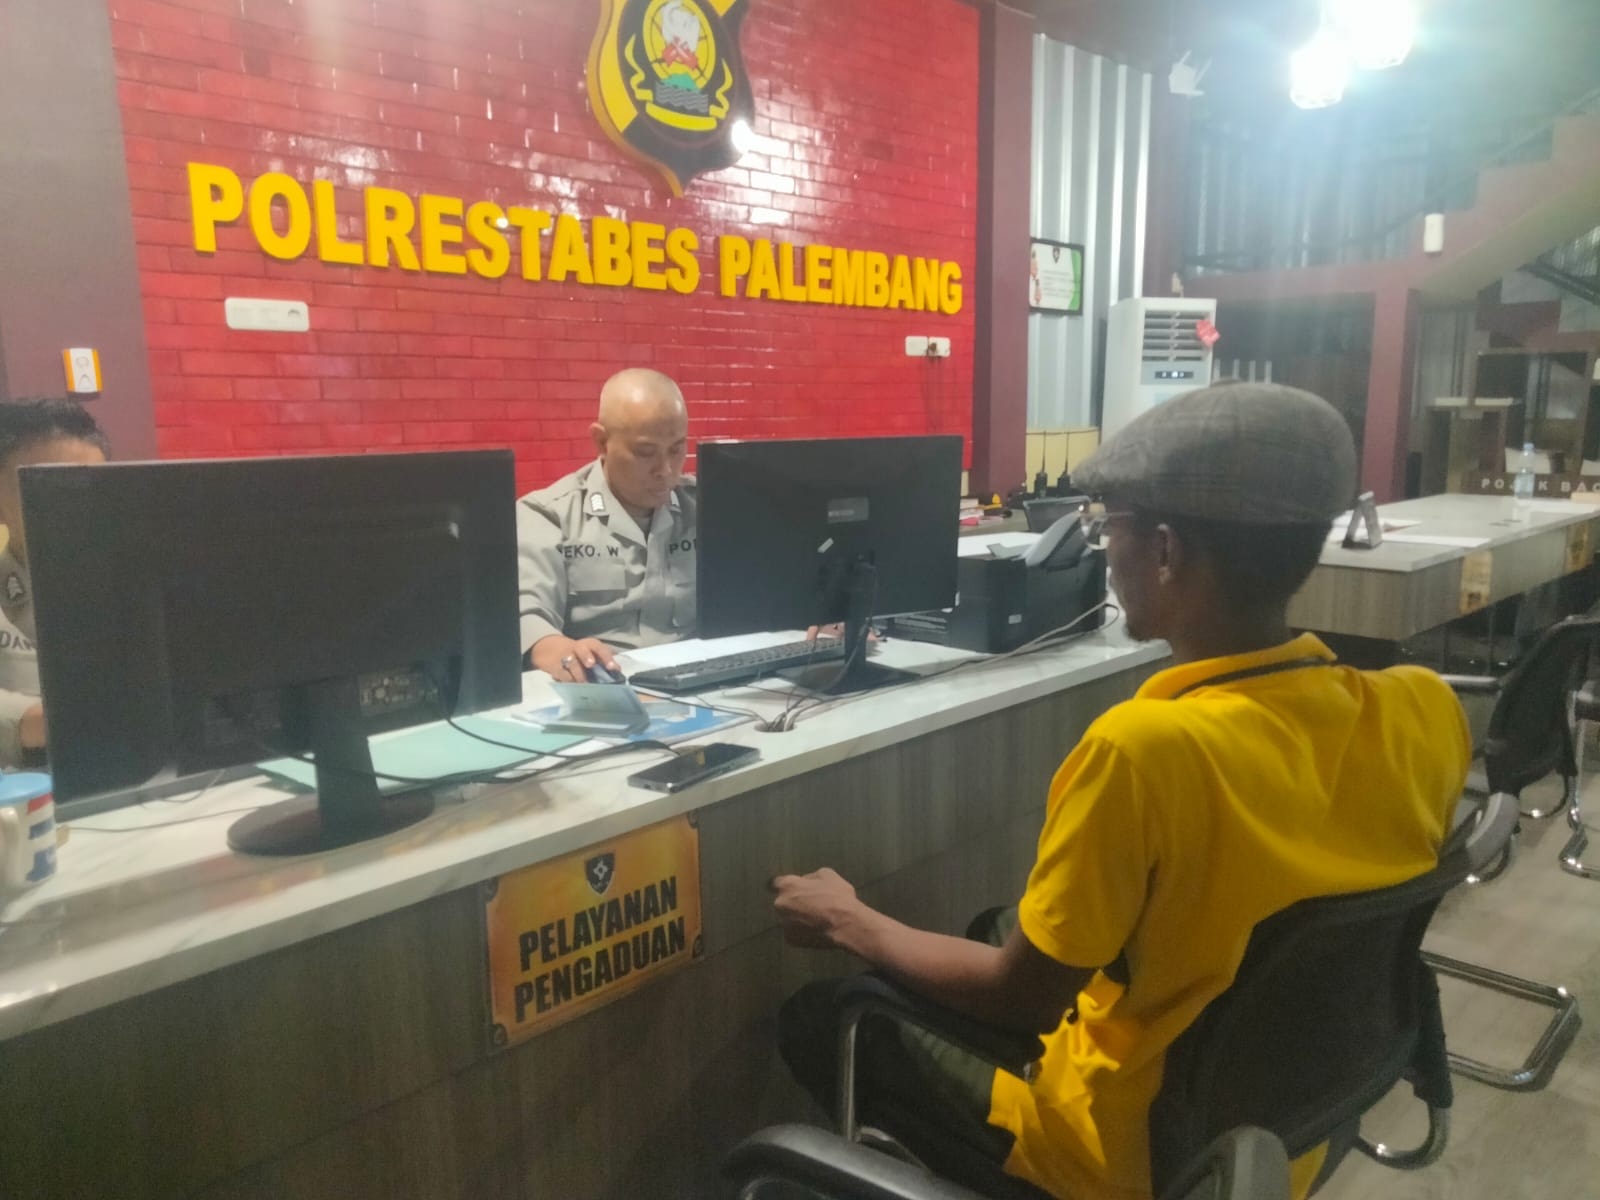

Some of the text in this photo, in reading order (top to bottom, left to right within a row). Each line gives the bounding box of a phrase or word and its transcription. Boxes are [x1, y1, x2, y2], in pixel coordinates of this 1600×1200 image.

[187, 161, 963, 315] POLRESTABES PALEMBANG
[1482, 478, 1549, 492] POK
[514, 915, 685, 1024] PENGADUAN
[518, 875, 678, 972] PELAYANAN
